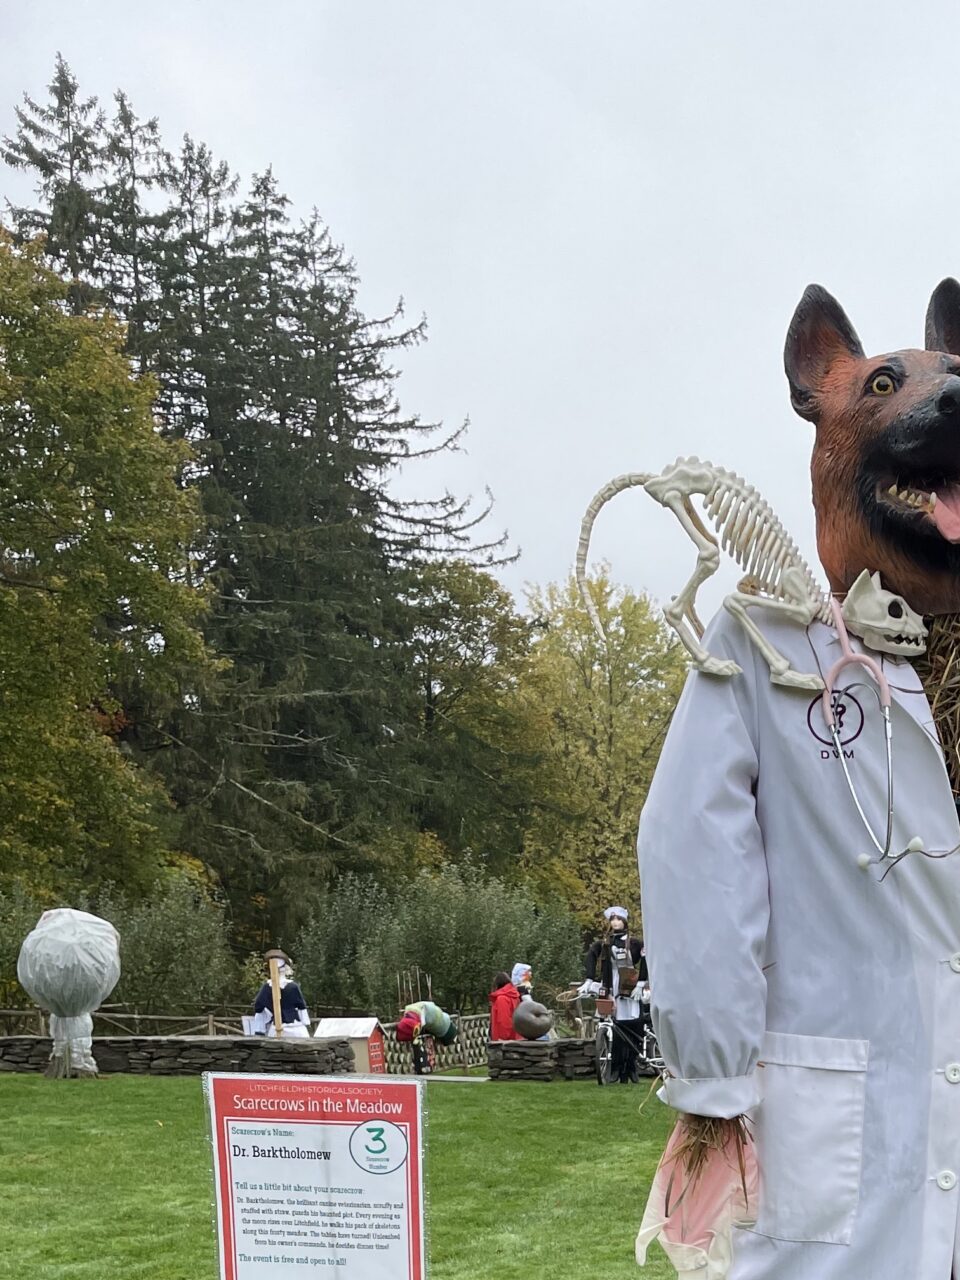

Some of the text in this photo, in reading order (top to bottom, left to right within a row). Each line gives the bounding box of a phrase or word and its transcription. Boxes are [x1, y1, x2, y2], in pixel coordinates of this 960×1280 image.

[233, 1094, 403, 1114] Scarecrows in the Meadow
[231, 1127, 294, 1136] Scarecrow's Name:
[365, 1128, 387, 1154] 3
[232, 1145, 331, 1160] Dr. Barktholomew
[294, 1184, 312, 1192] about
[314, 1186, 328, 1194] your
[281, 1255, 294, 1263] free
[296, 1256, 308, 1264] and
[310, 1258, 326, 1266] open
[336, 1258, 346, 1266] all!
